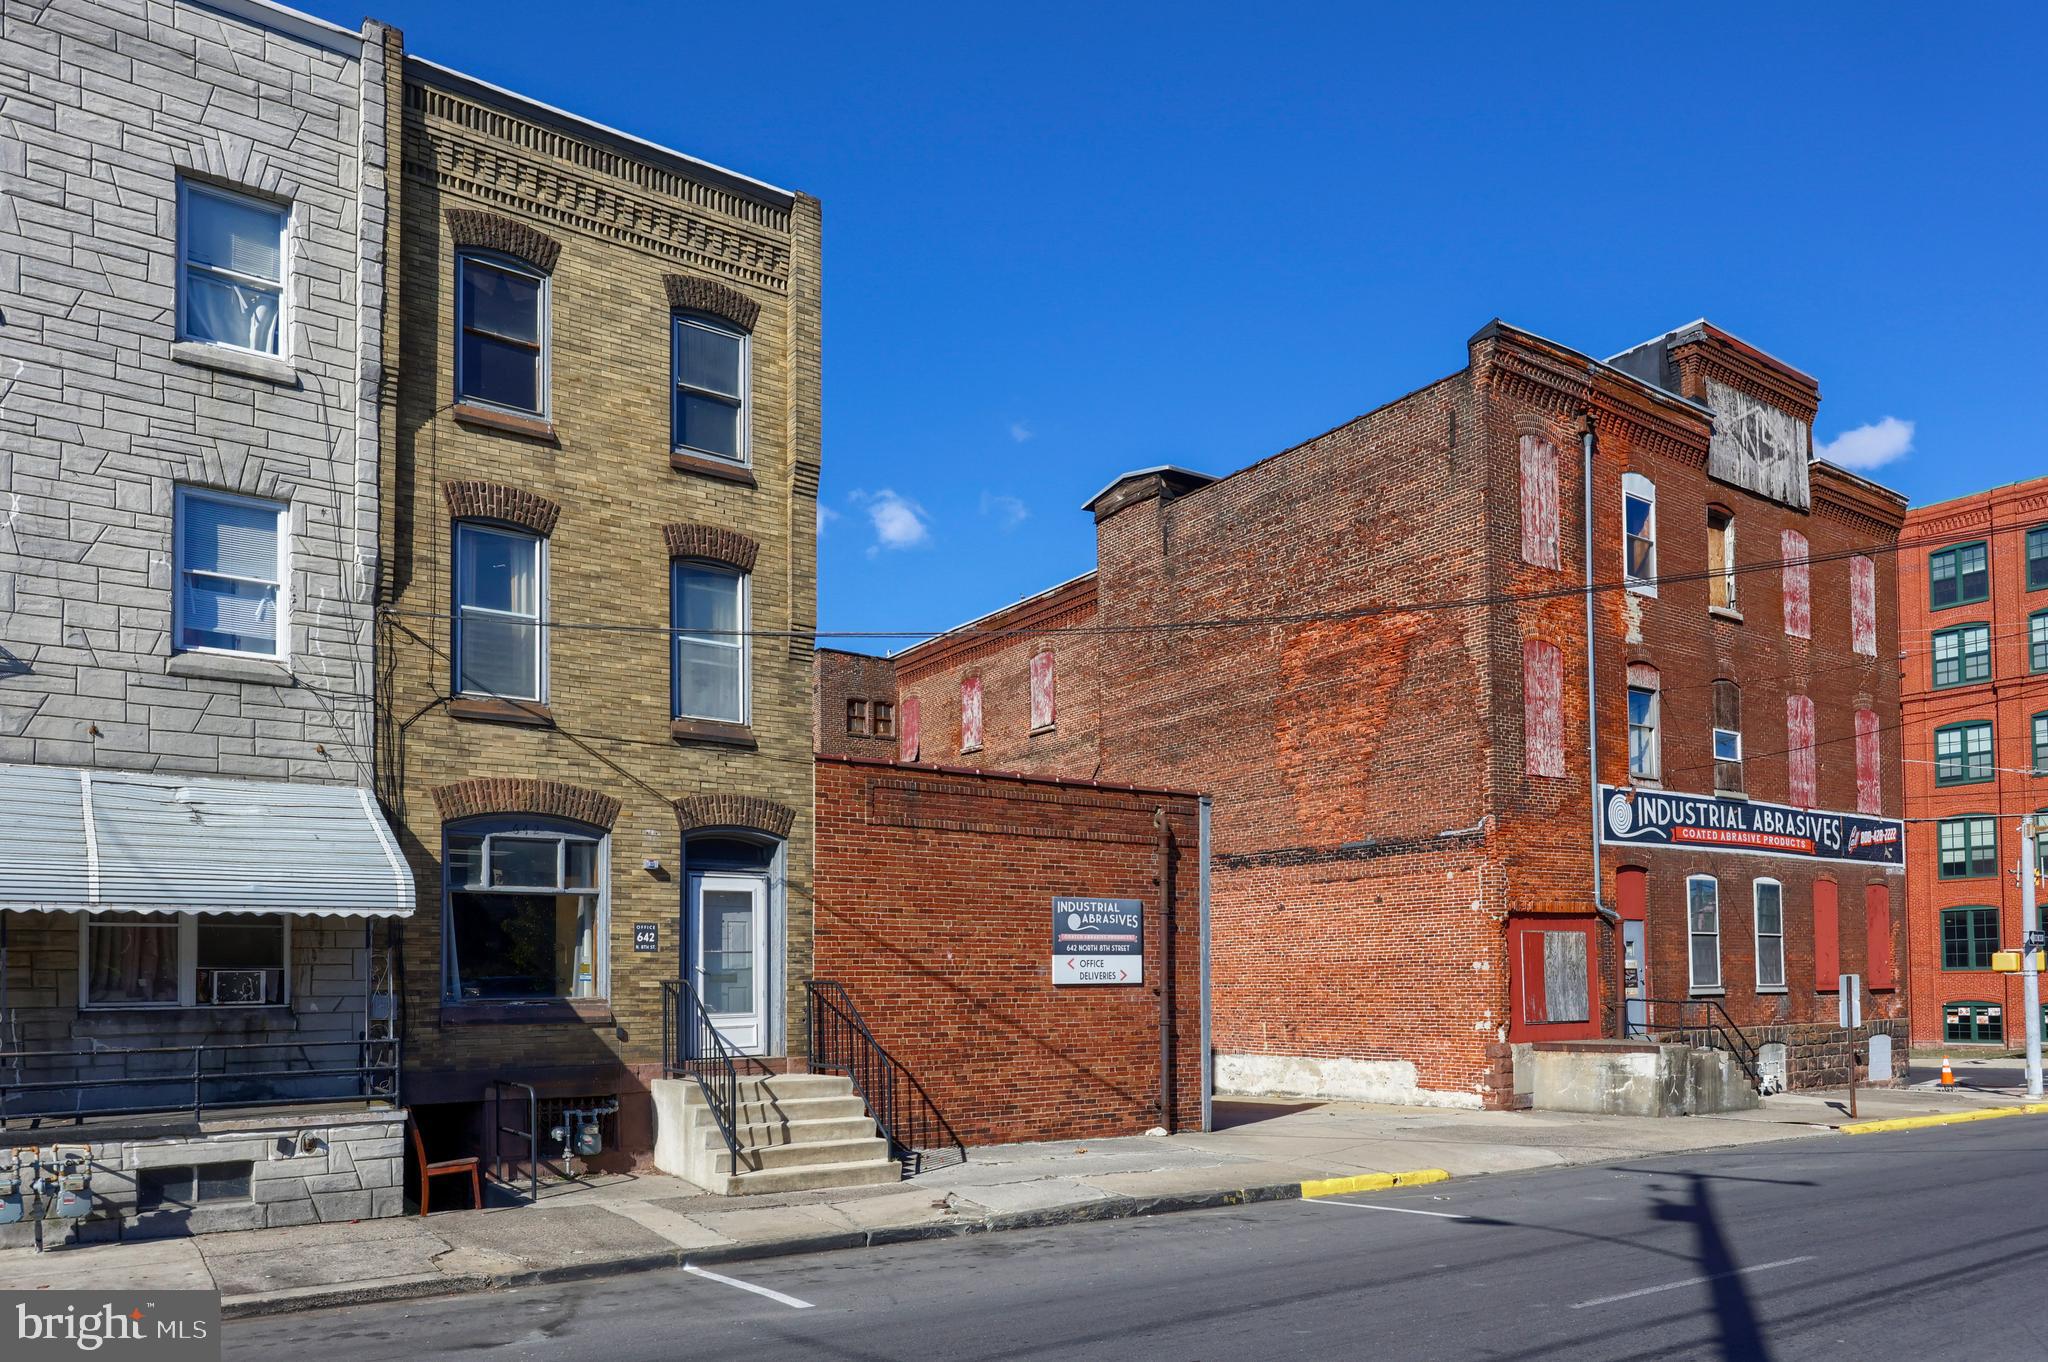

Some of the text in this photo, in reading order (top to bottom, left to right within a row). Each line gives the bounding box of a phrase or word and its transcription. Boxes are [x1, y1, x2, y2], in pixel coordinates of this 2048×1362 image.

[1638, 797, 1840, 850] INDUSTRIAL ABRASIVES
[1682, 828, 1806, 848] COATED ABRASIVE PRODUCTS
[1057, 901, 1120, 913] INDUSTRIAL
[1082, 913, 1138, 928] ABRASIVES
[637, 932, 655, 942] 642
[1080, 960, 1104, 968] OFFICE
[1079, 971, 1116, 980] DELIVERIES
